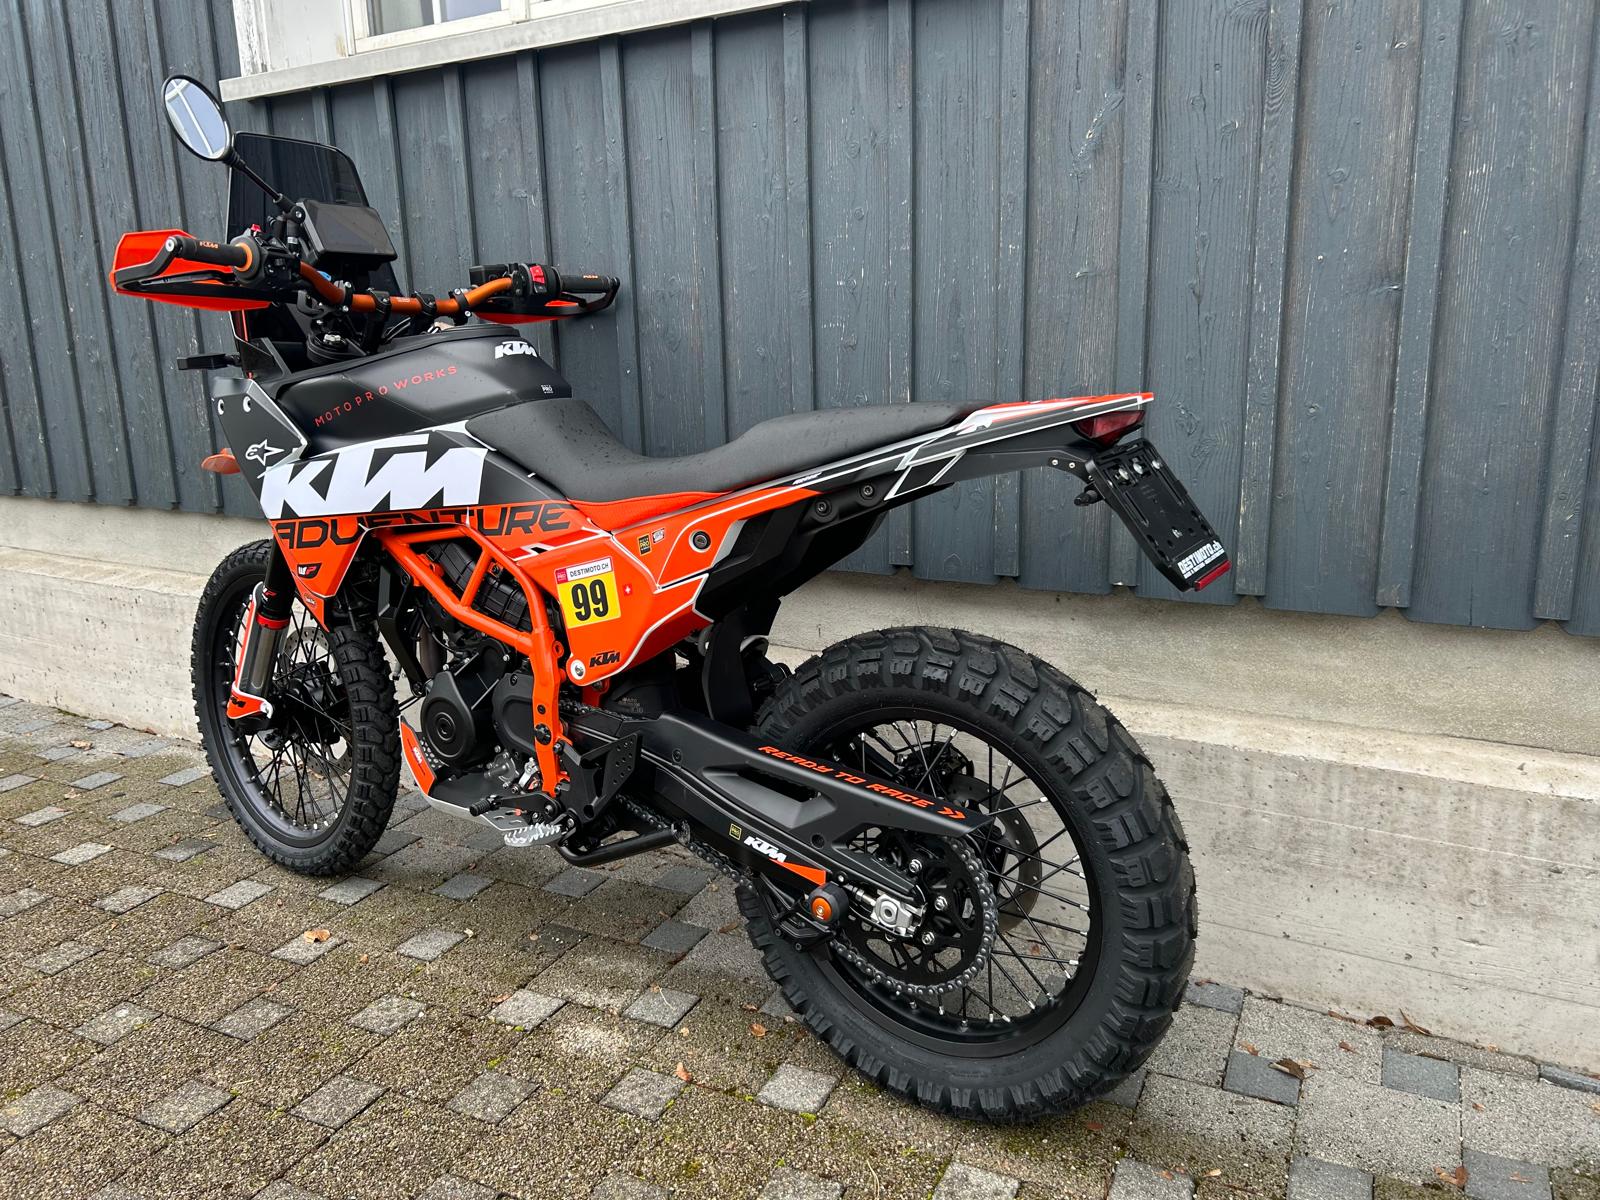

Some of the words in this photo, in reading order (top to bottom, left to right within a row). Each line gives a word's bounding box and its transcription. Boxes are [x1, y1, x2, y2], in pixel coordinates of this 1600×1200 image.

[495, 341, 537, 359] KTM
[260, 434, 488, 519] KTM
[276, 503, 571, 549] ADVENTURE
[571, 579, 609, 621] 99
[589, 650, 620, 667] KTM
[758, 746, 834, 772] READY
[835, 771, 866, 784] TO
[866, 783, 934, 808] RACE
[744, 835, 787, 863] KTM
